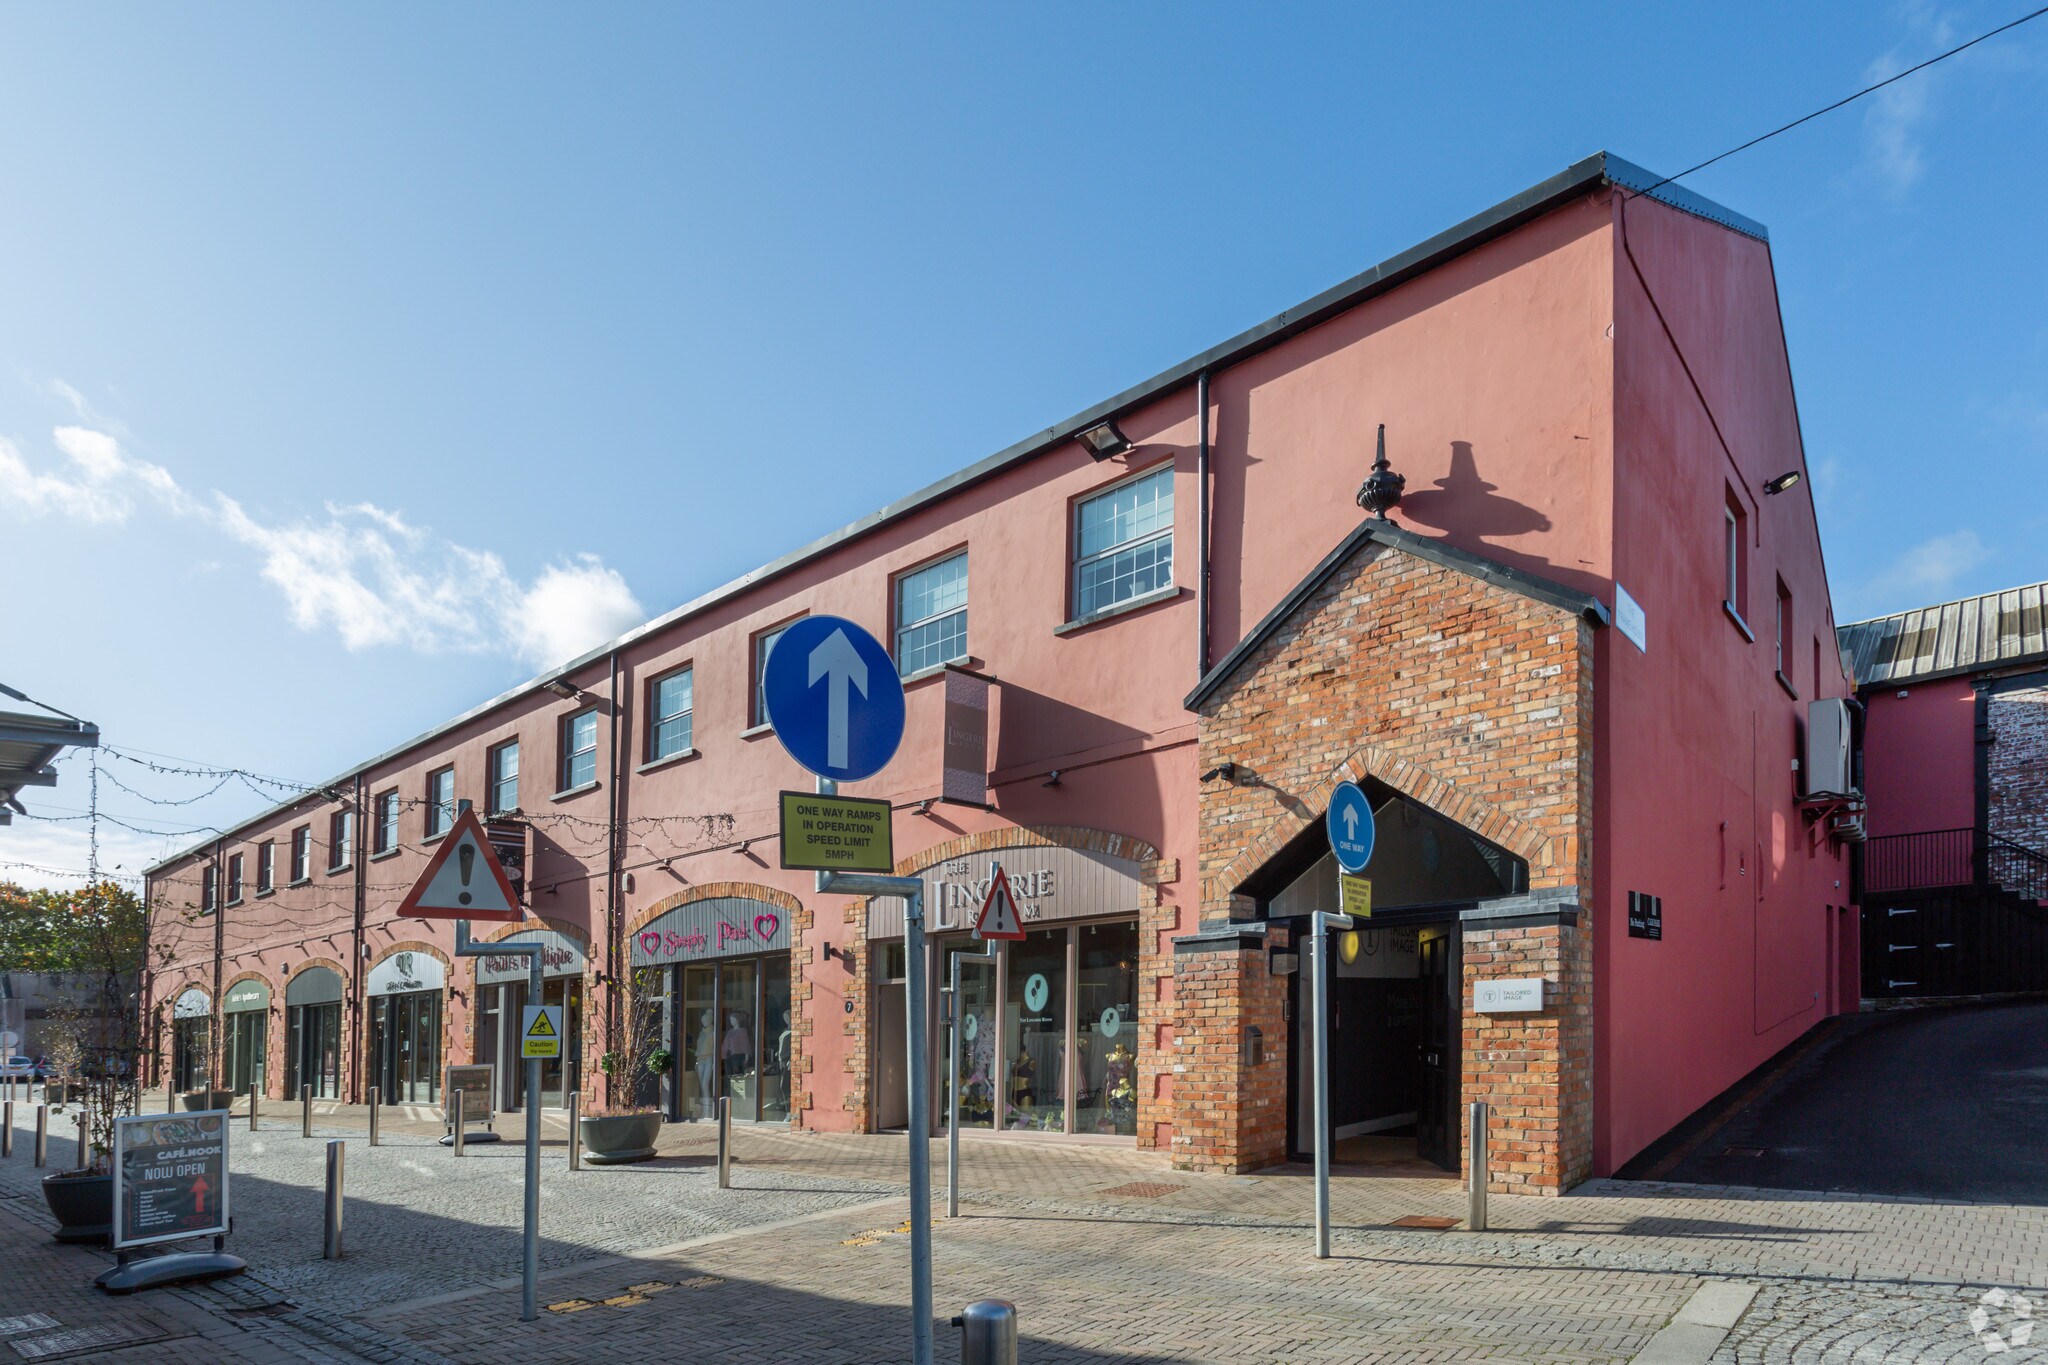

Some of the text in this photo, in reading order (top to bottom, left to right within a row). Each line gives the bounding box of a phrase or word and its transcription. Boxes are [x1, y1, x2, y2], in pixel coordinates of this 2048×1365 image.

[948, 725, 986, 746] LINGERIE
[797, 805, 881, 821] ONE WAY RAMPS
[803, 820, 874, 834] IN OPERATION
[807, 834, 871, 848] SPEED LIMIT
[1340, 840, 1365, 853] ONE WAY
[825, 850, 854, 860] 5MPH
[943, 861, 967, 876] THE
[932, 870, 1052, 930] LINGRIE
[664, 919, 750, 954] Simply Pink
[1390, 938, 1415, 953] IMAGE
[847, 1002, 852, 1012] 7
[145, 1162, 206, 1180] NOW OPEN
